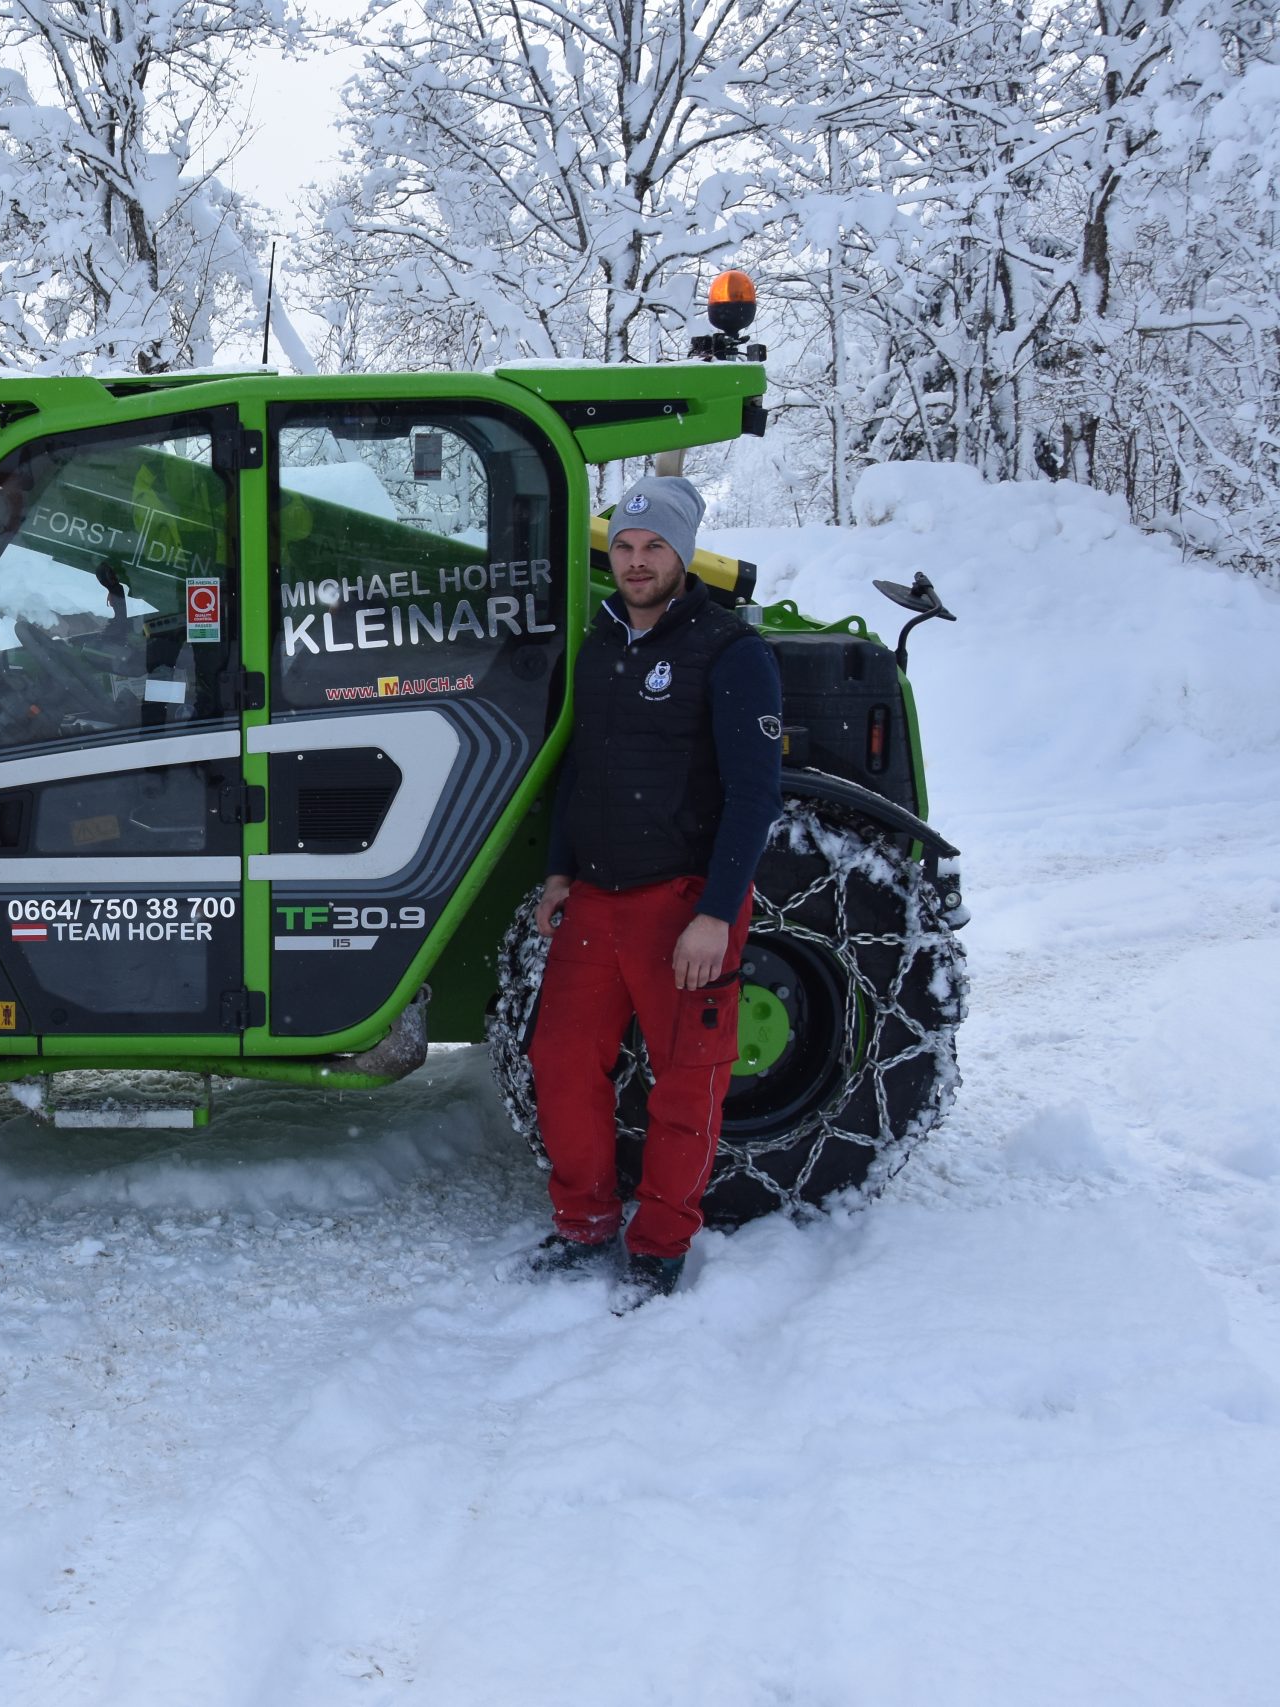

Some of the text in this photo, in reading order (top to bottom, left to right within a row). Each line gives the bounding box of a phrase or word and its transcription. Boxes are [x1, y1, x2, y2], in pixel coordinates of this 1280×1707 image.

[32, 505, 124, 549] FORST
[280, 558, 553, 608] MICHAEL HOFER
[283, 592, 557, 657] KLEINARL
[325, 673, 475, 701] www.MAUCH.at
[7, 898, 82, 921] 0664/
[89, 898, 138, 920] 750
[145, 897, 179, 919] 38
[186, 896, 236, 919] 700
[276, 906, 426, 930] TF30.9
[52, 922, 213, 941] TEAM HOFER
